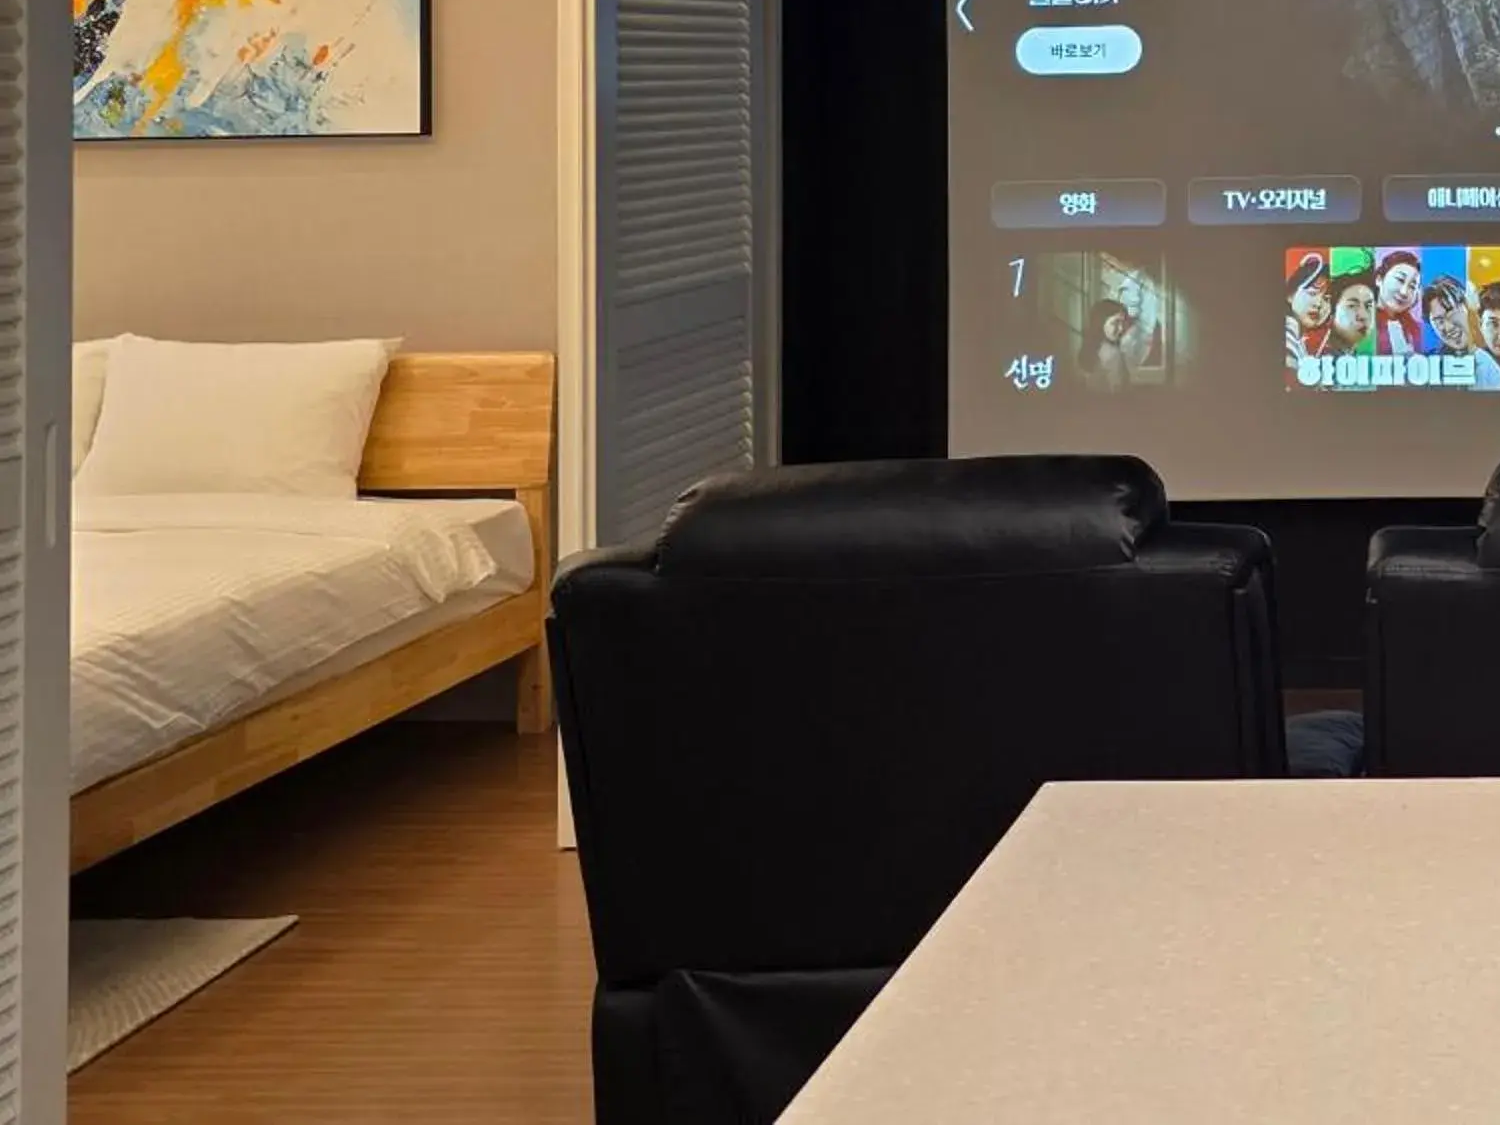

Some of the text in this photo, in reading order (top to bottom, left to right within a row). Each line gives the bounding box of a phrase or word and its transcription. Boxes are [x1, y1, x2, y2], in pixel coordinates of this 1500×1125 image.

[1050, 42, 1107, 60] 바로보기
[1059, 191, 1098, 216] 영화
[1008, 258, 1025, 298] 1
[1004, 354, 1055, 389] 신명
[1297, 353, 1477, 387] 하이파이브
